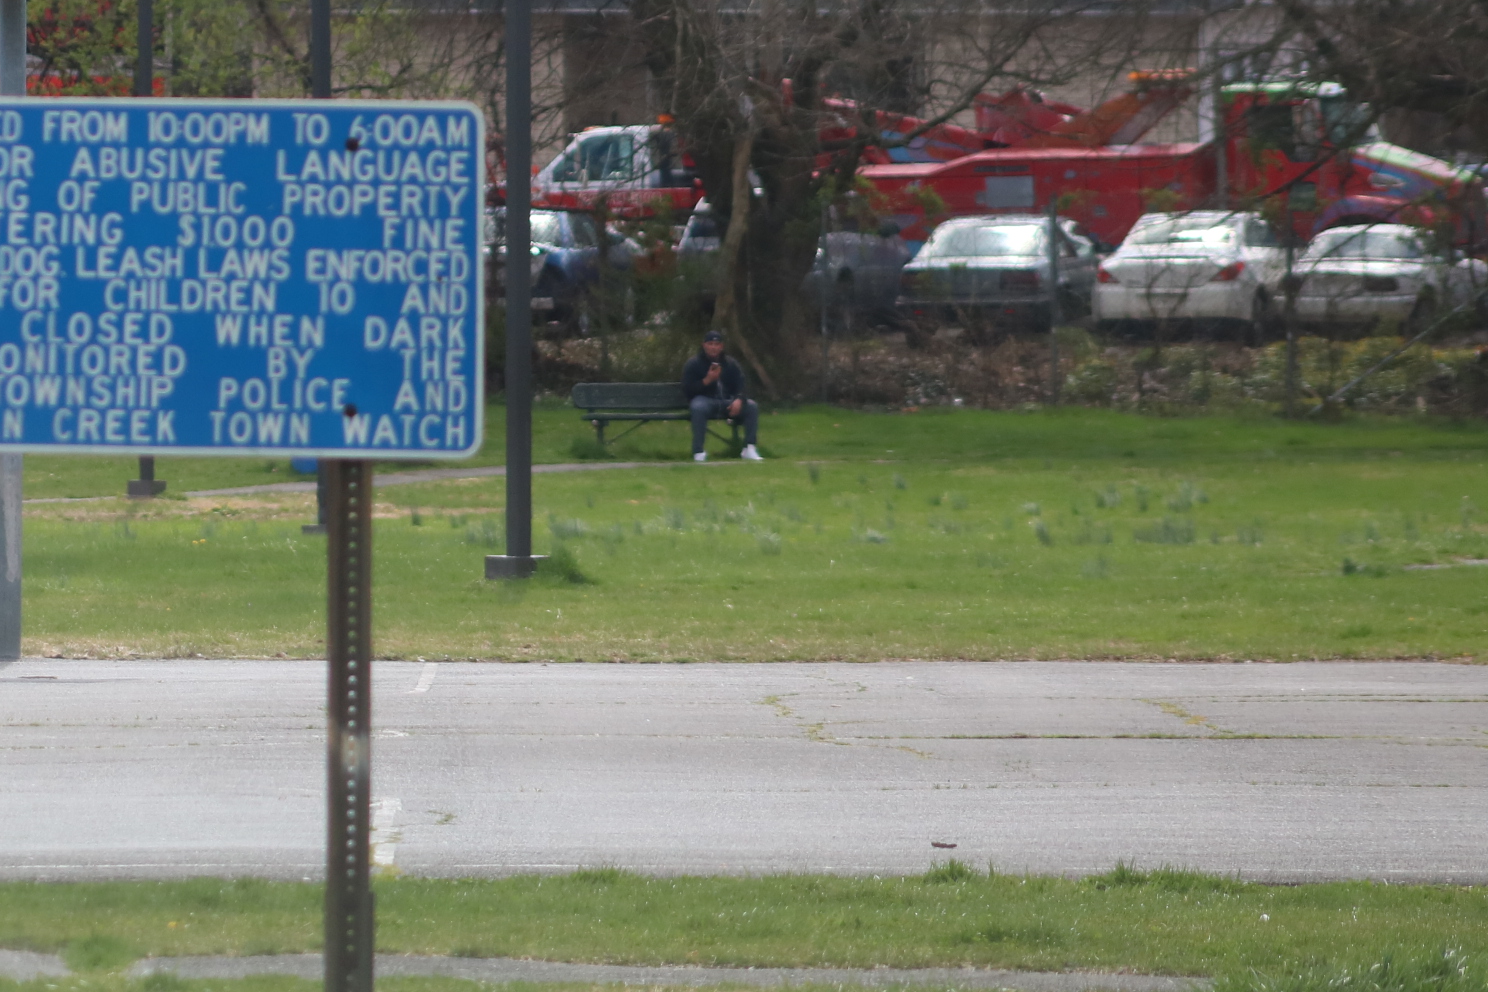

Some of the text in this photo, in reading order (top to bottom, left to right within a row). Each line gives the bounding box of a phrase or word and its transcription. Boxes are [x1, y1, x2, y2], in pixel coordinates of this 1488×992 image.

[43, 111, 128, 142] FROM
[148, 112, 269, 144] 10:00PM
[292, 113, 330, 145] TO
[349, 114, 469, 146] 6:00AM
[70, 146, 225, 180] ABUSIVE
[277, 149, 469, 182] LANGUAGE
[58, 180, 101, 212] OF
[131, 181, 246, 214] PUBLIC
[282, 184, 468, 217] PROPERTY
[383, 217, 465, 249] FINE
[76, 246, 184, 278] LEASH
[199, 247, 290, 279] LAWS
[306, 249, 468, 282] ENFORCED
[104, 279, 276, 313] CHILDREN
[319, 282, 355, 314] 10
[401, 283, 467, 315] AND
[21, 311, 173, 345] CLOSED
[215, 314, 324, 348] WHEN
[364, 316, 466, 350] DARK
[268, 348, 313, 379] BY
[399, 349, 465, 381] THE
[219, 378, 351, 410] POLICE
[394, 379, 467, 411] AND
[53, 409, 176, 442] CREEK
[210, 411, 309, 444] TOWN
[343, 413, 465, 446] WATCH
